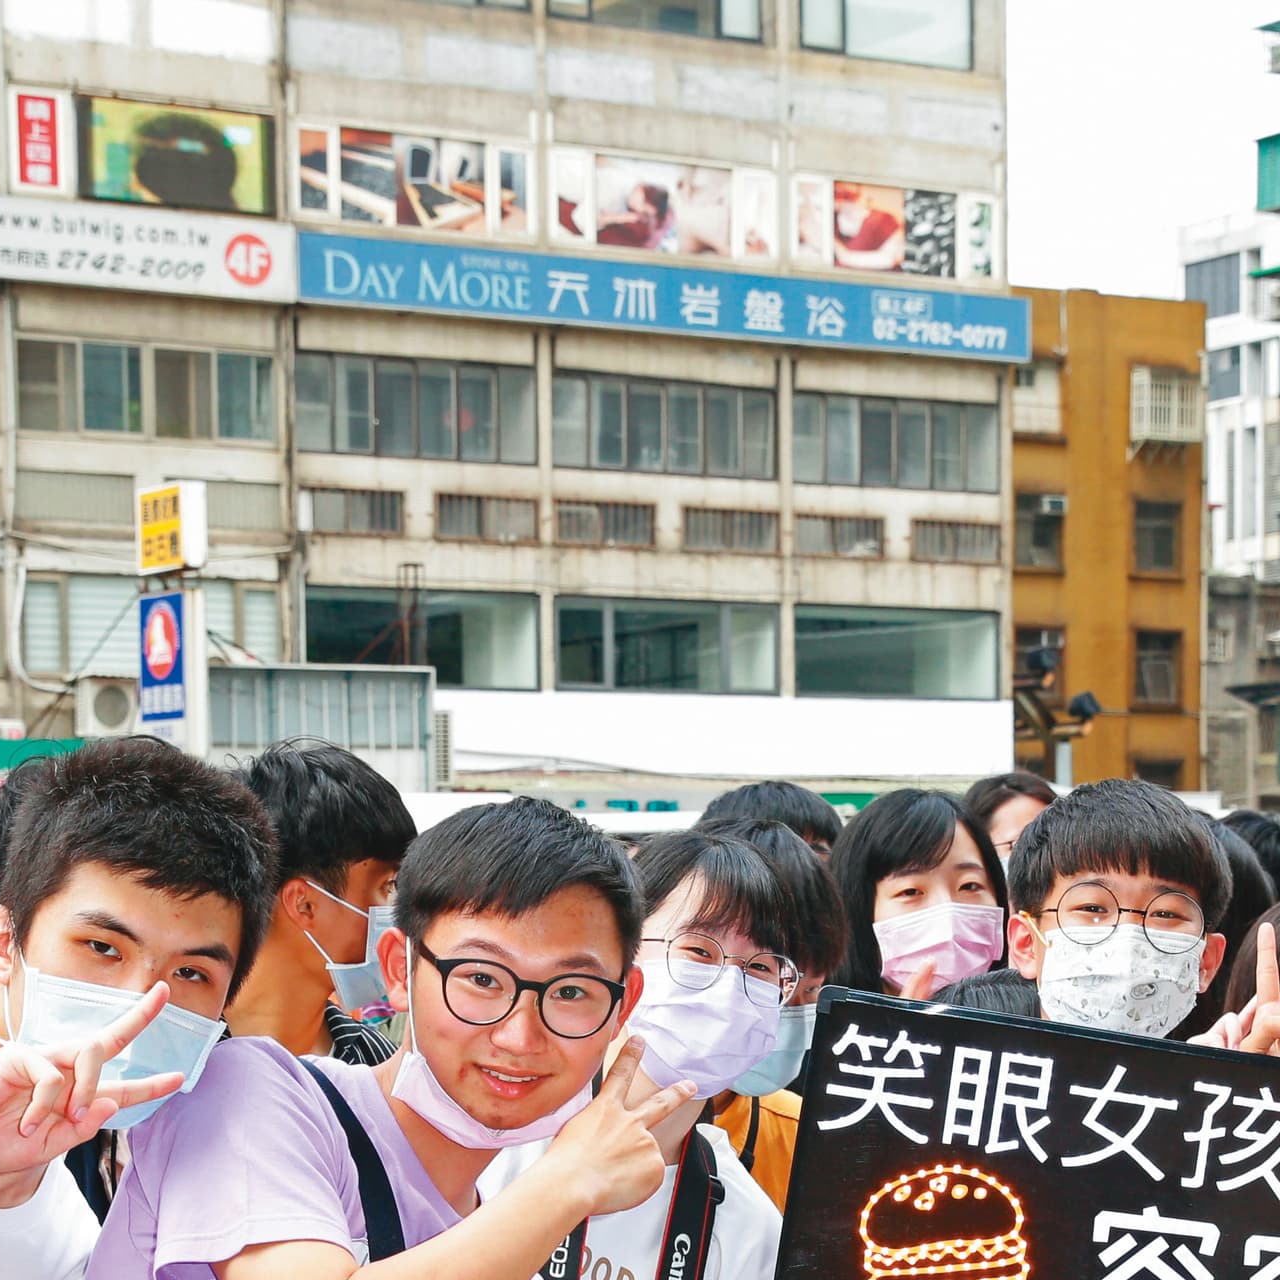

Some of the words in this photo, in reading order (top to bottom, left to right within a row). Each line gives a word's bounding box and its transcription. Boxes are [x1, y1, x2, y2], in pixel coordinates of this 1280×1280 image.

[56, 249, 207, 283] 2742-2009
[227, 240, 272, 279] 4F
[547, 269, 848, 338] 天沐岩盤浴
[872, 317, 1009, 350] 02-2762-0077
